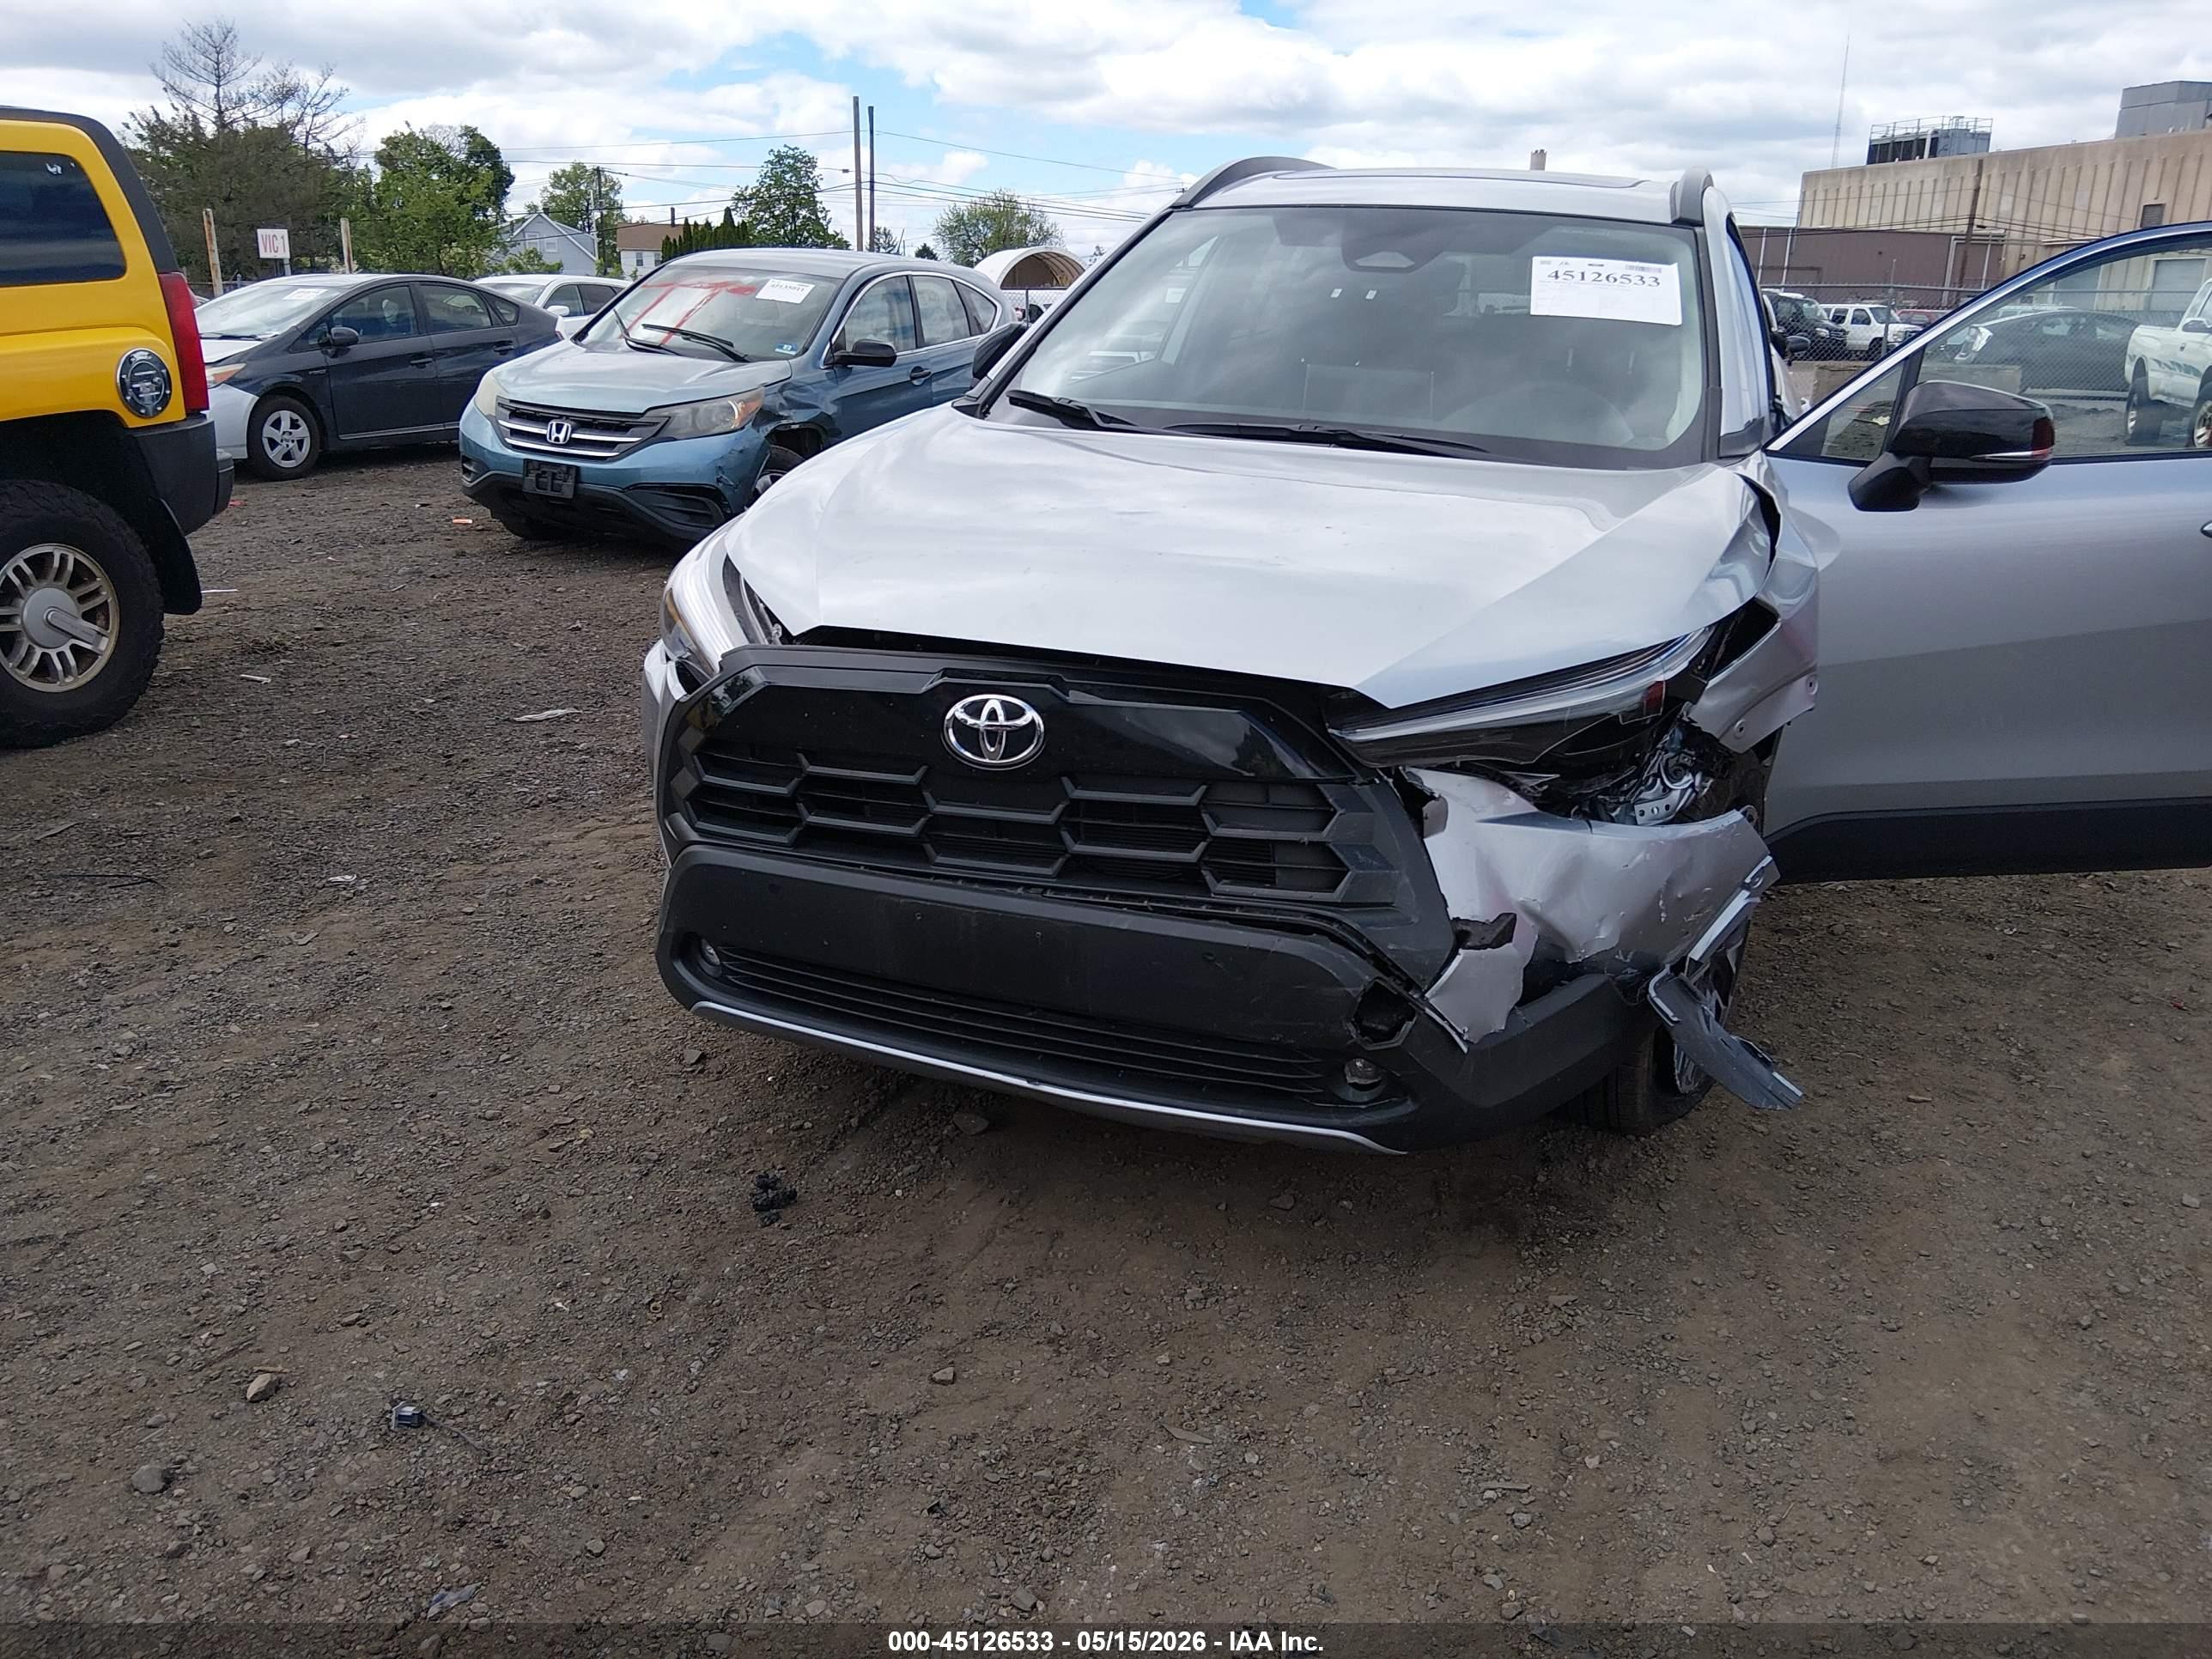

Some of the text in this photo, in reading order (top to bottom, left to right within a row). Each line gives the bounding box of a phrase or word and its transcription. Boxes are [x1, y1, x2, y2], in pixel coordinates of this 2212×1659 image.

[261, 234, 286, 253] VIC 1
[1547, 269, 1661, 288] 45126533
